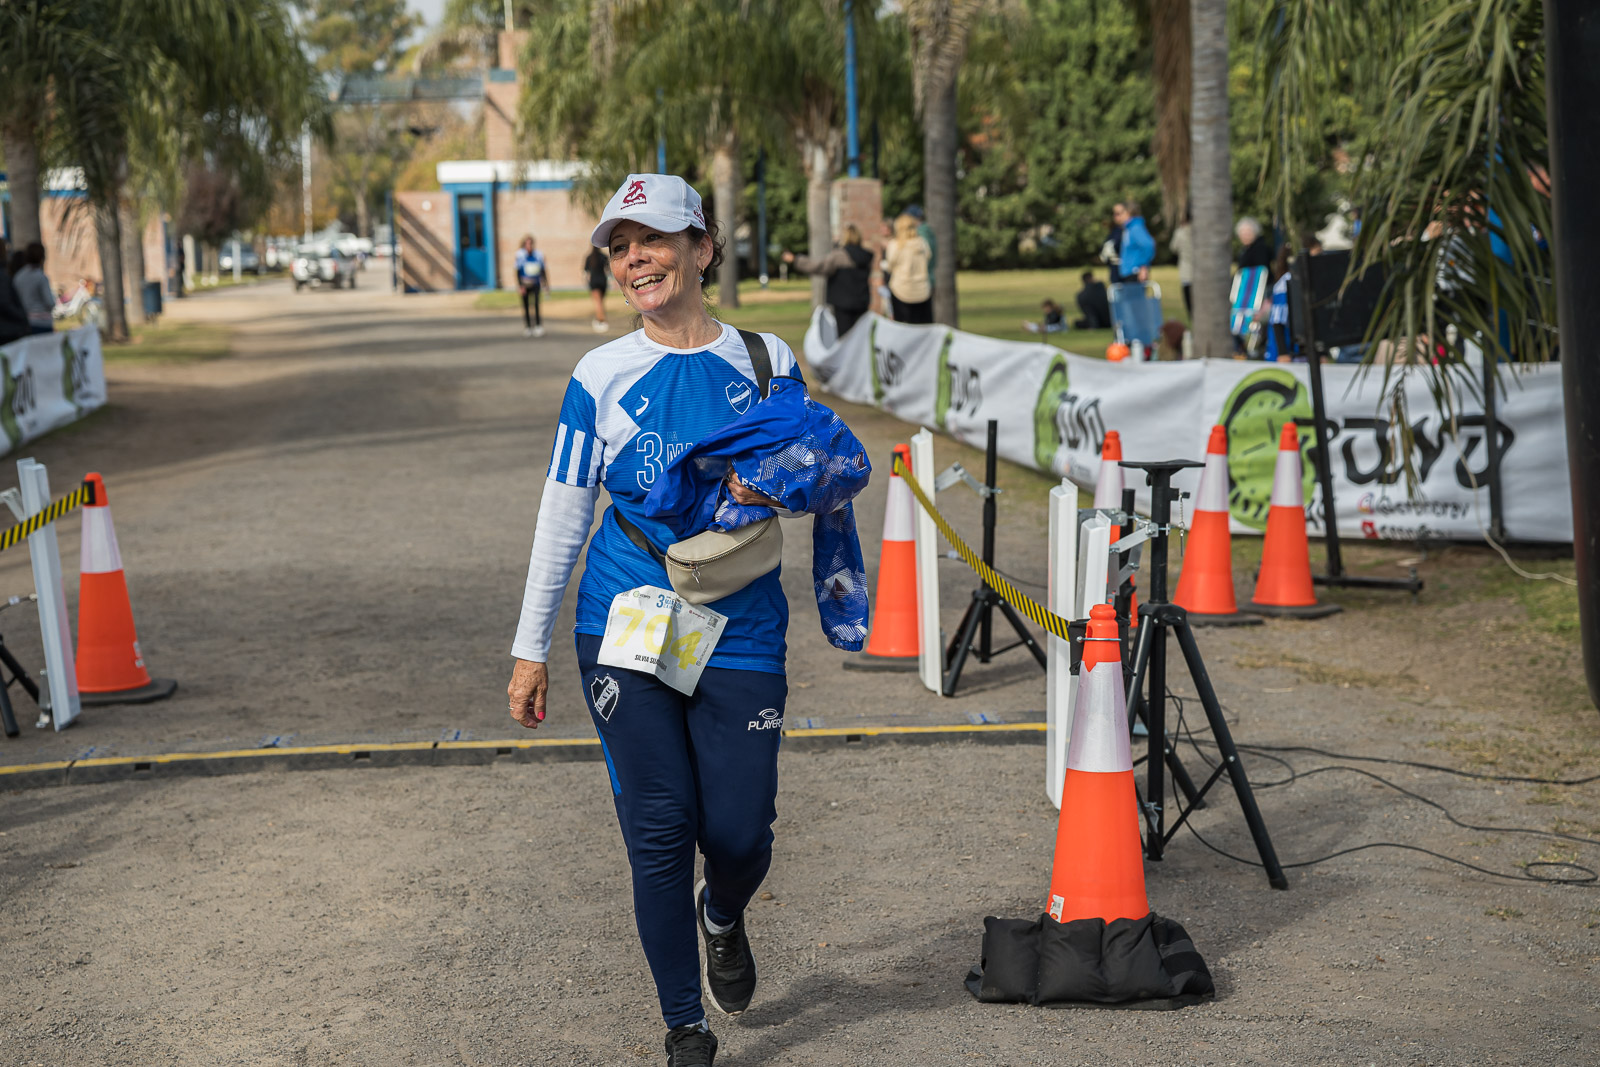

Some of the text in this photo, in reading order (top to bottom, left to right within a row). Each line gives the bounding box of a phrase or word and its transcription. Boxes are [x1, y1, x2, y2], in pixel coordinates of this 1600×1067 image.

[636, 431, 663, 491] 3
[656, 594, 665, 608] 3
[614, 606, 703, 670] 704
